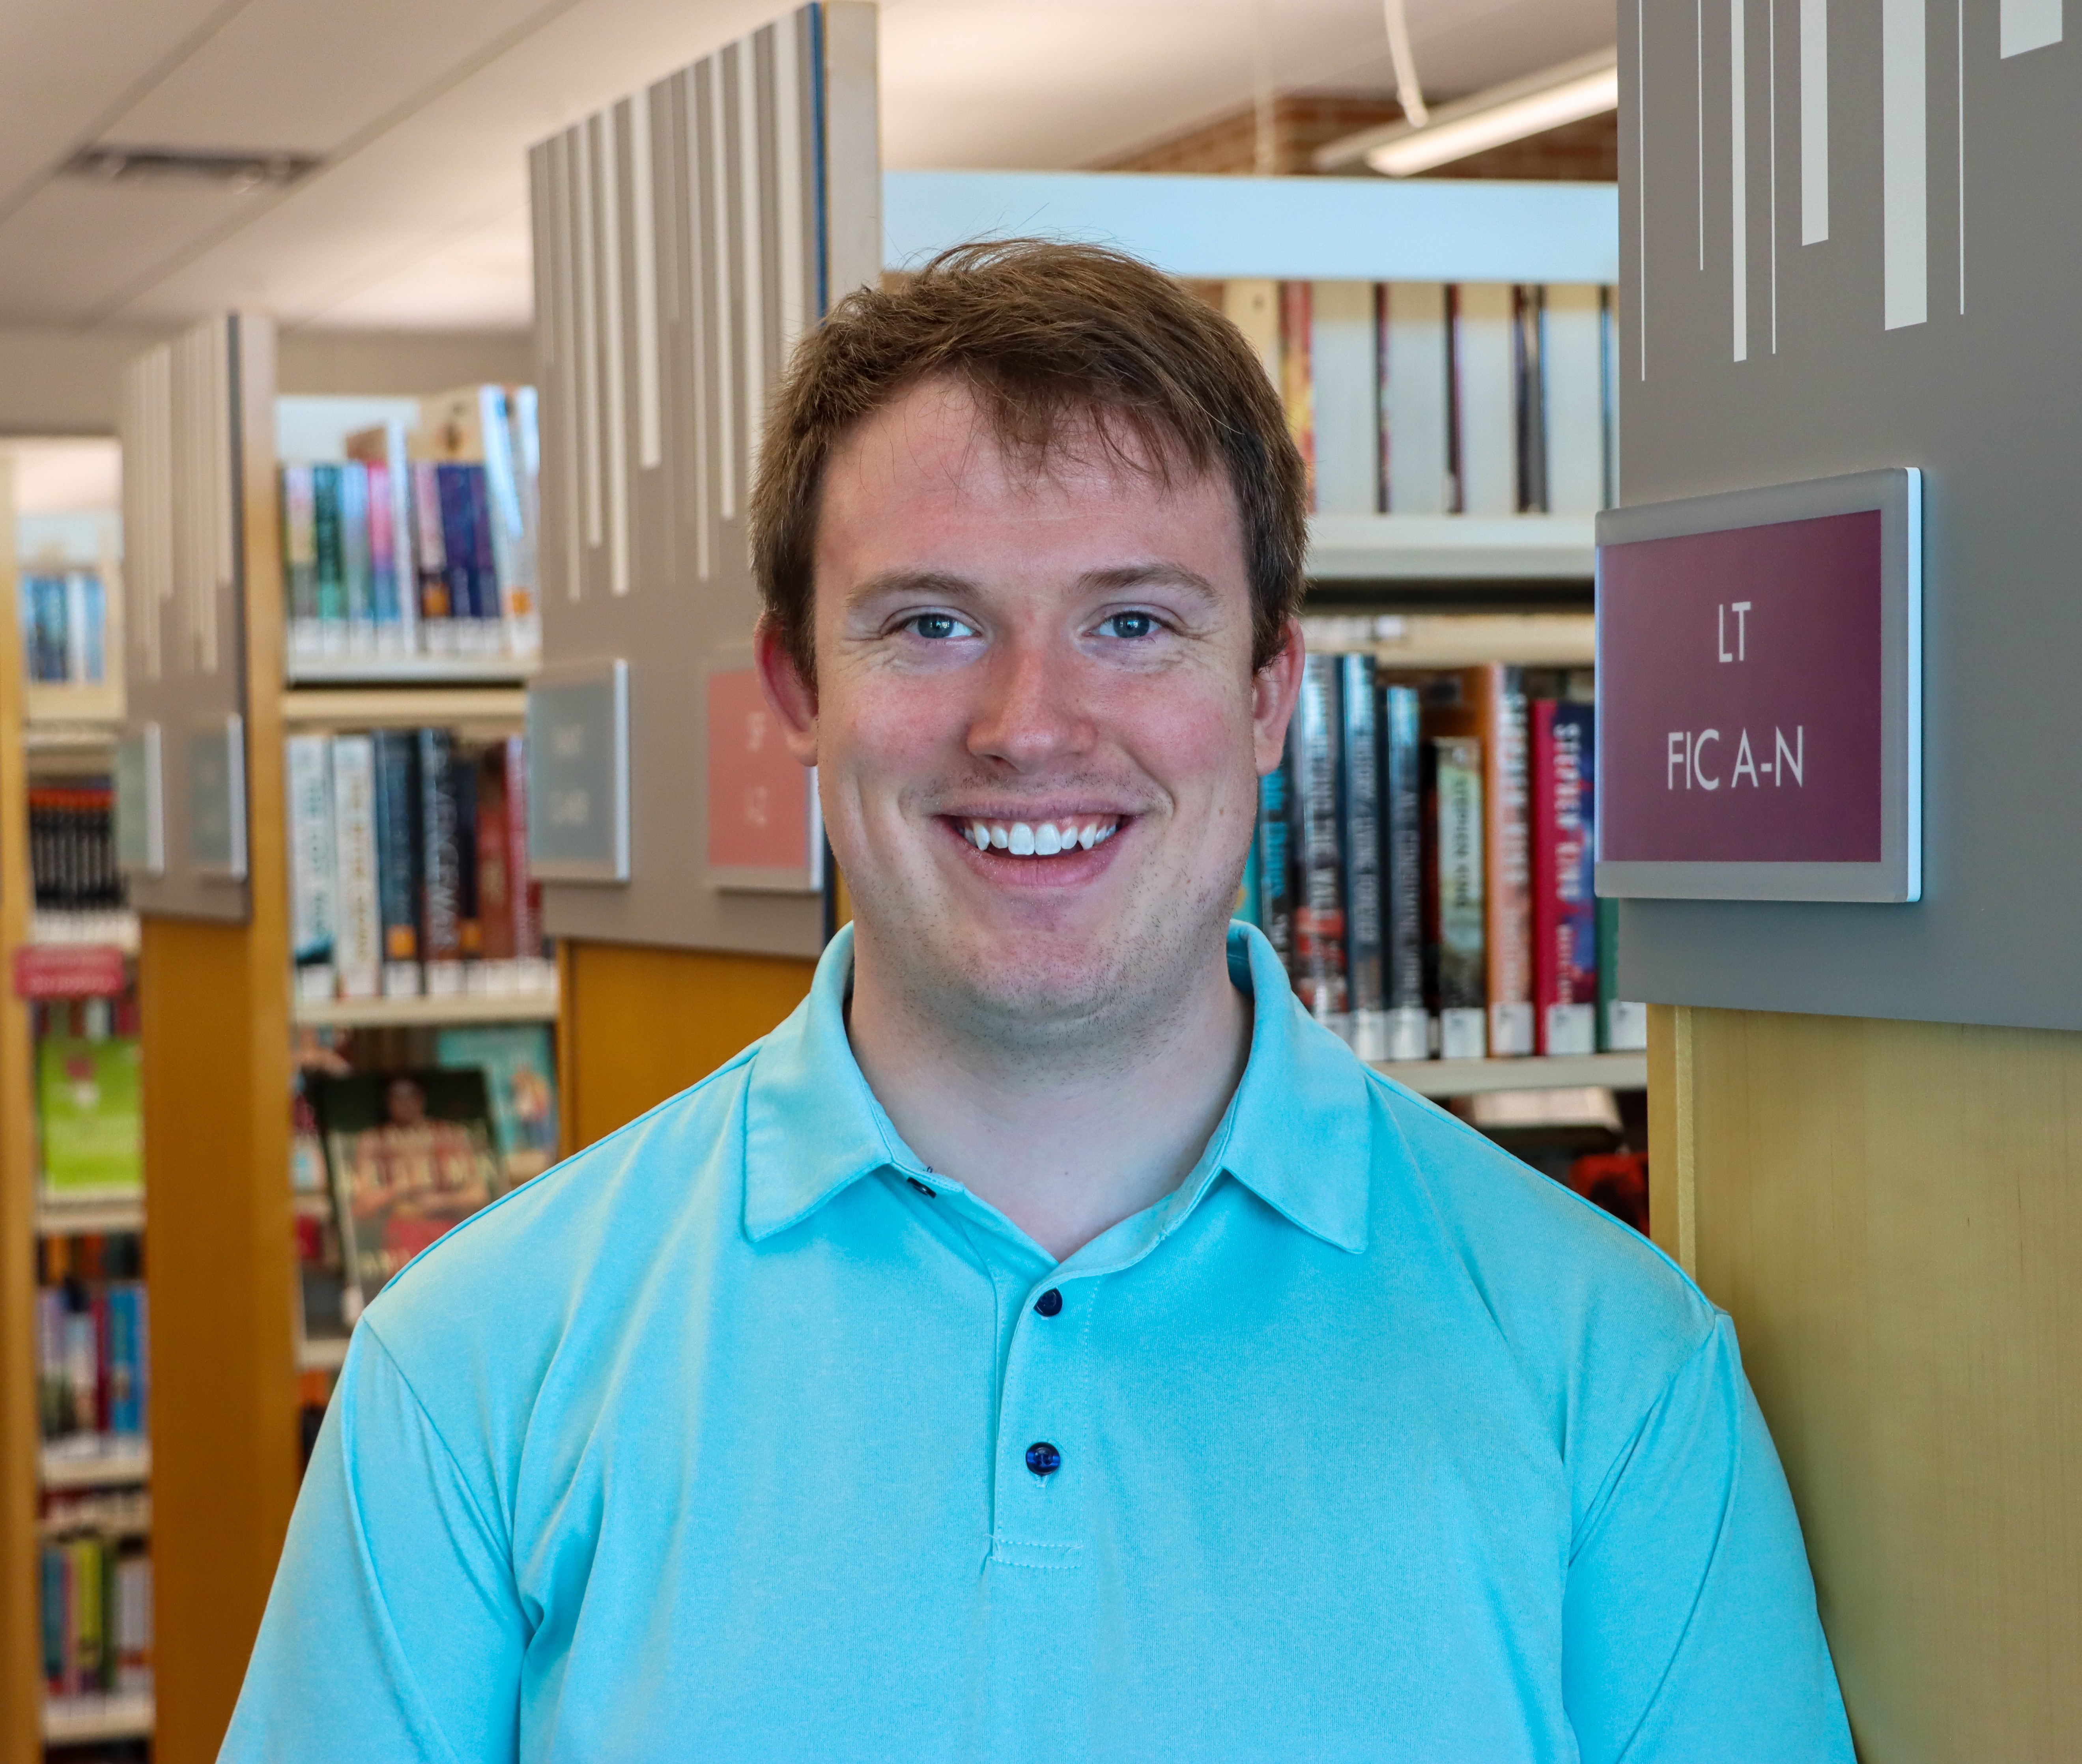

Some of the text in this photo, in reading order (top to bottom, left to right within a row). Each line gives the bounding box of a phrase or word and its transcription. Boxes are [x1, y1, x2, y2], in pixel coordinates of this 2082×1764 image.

[1719, 601, 1751, 663] LT
[1553, 723, 1580, 829] STEPHEN
[1668, 726, 1803, 790] FIC A-N
[1452, 776, 1469, 855] STEPHEN
[1555, 841, 1582, 900] KING
